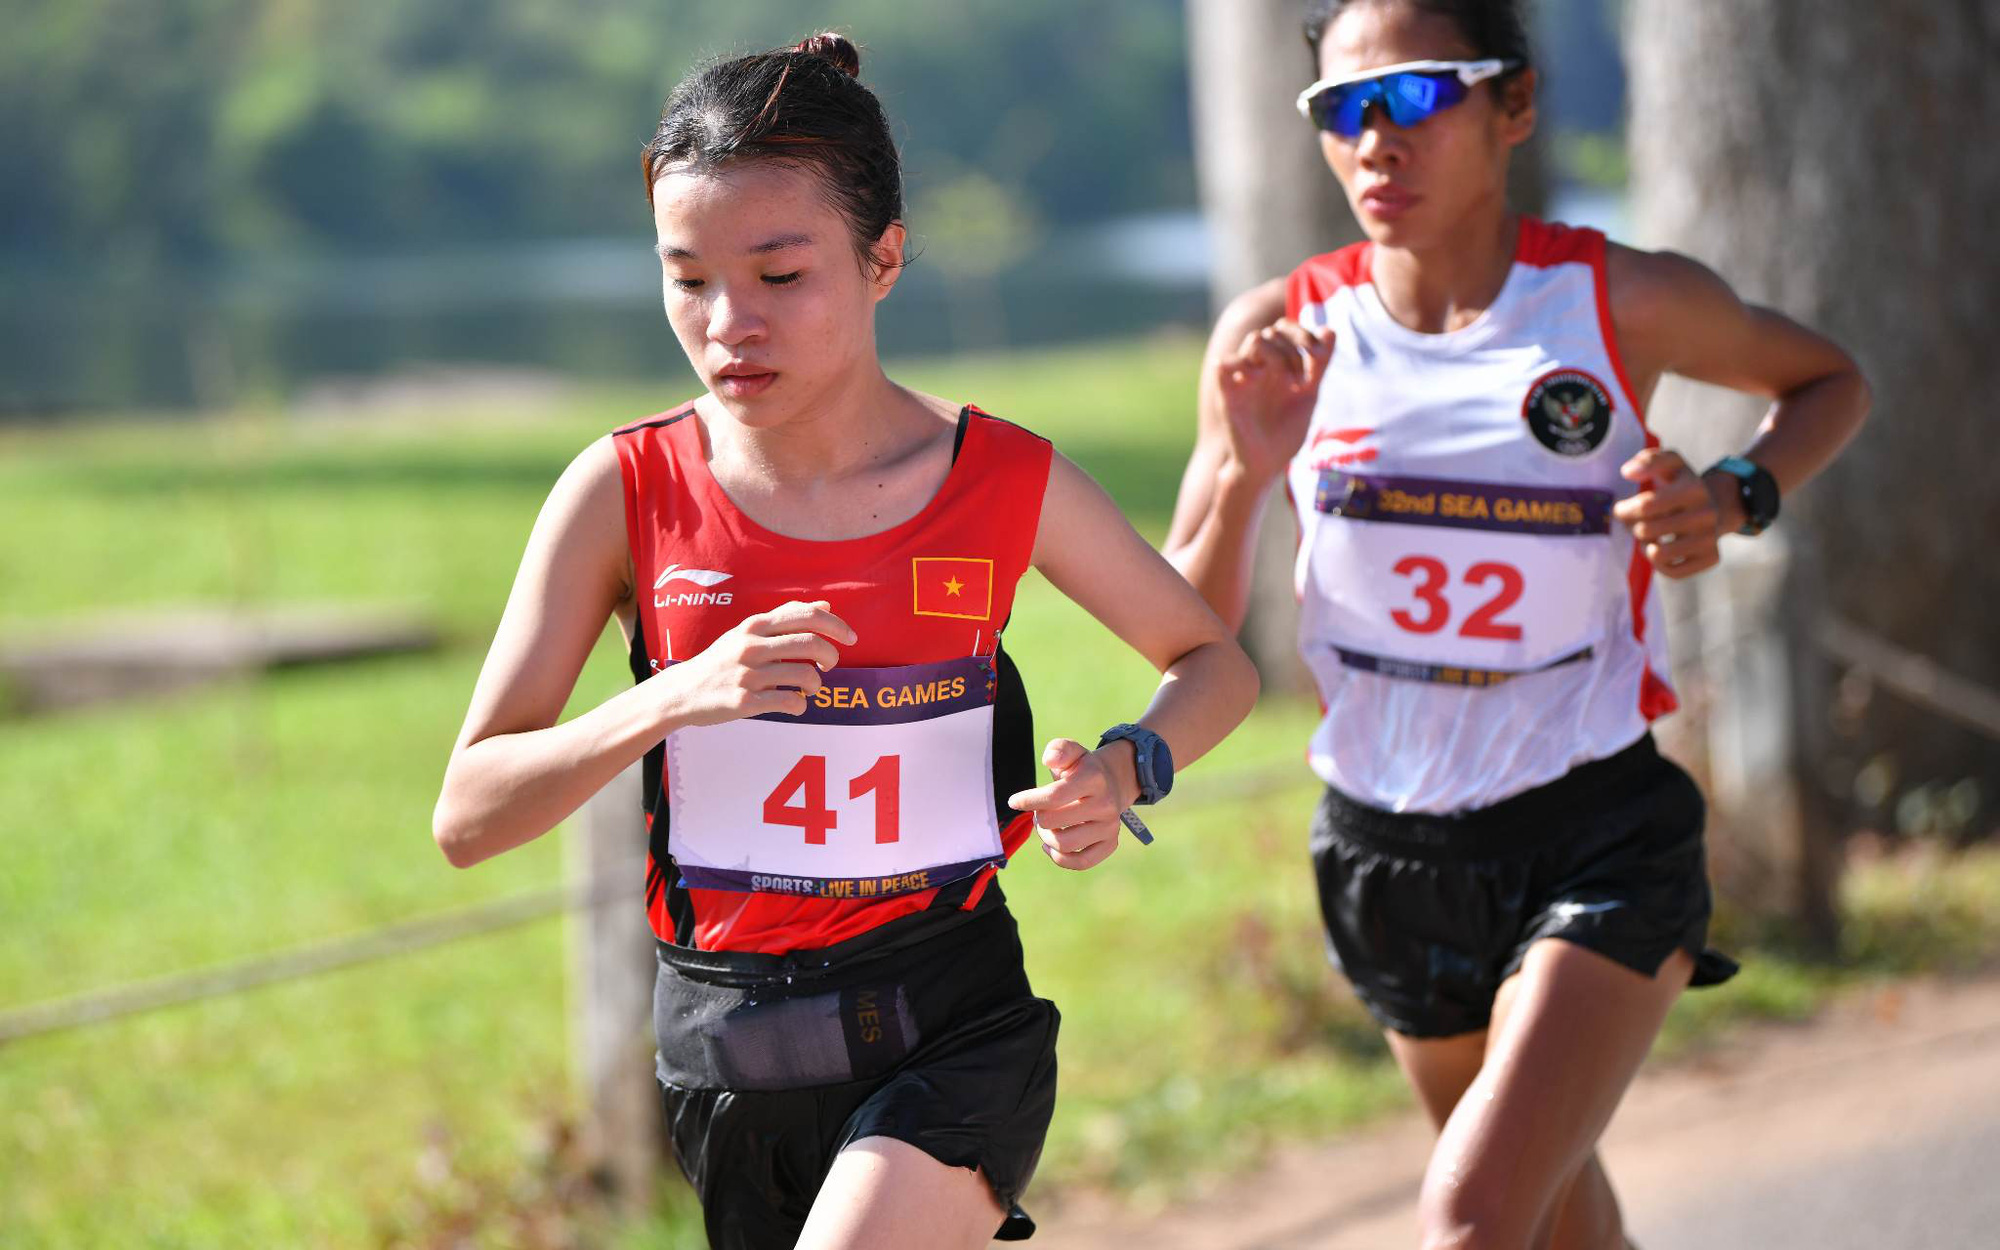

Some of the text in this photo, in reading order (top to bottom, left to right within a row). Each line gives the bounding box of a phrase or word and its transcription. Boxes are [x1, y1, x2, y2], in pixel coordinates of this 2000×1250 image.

[1378, 489, 1585, 525] 32nd SEA GAMES
[654, 592, 734, 609] LI-NING
[1390, 556, 1524, 641] 32
[814, 686, 870, 709] SEA
[876, 676, 967, 708] GAMES
[762, 754, 901, 845] 41
[859, 880, 877, 897] IN
[881, 871, 930, 895] PEACE
[858, 990, 883, 1043] MES
